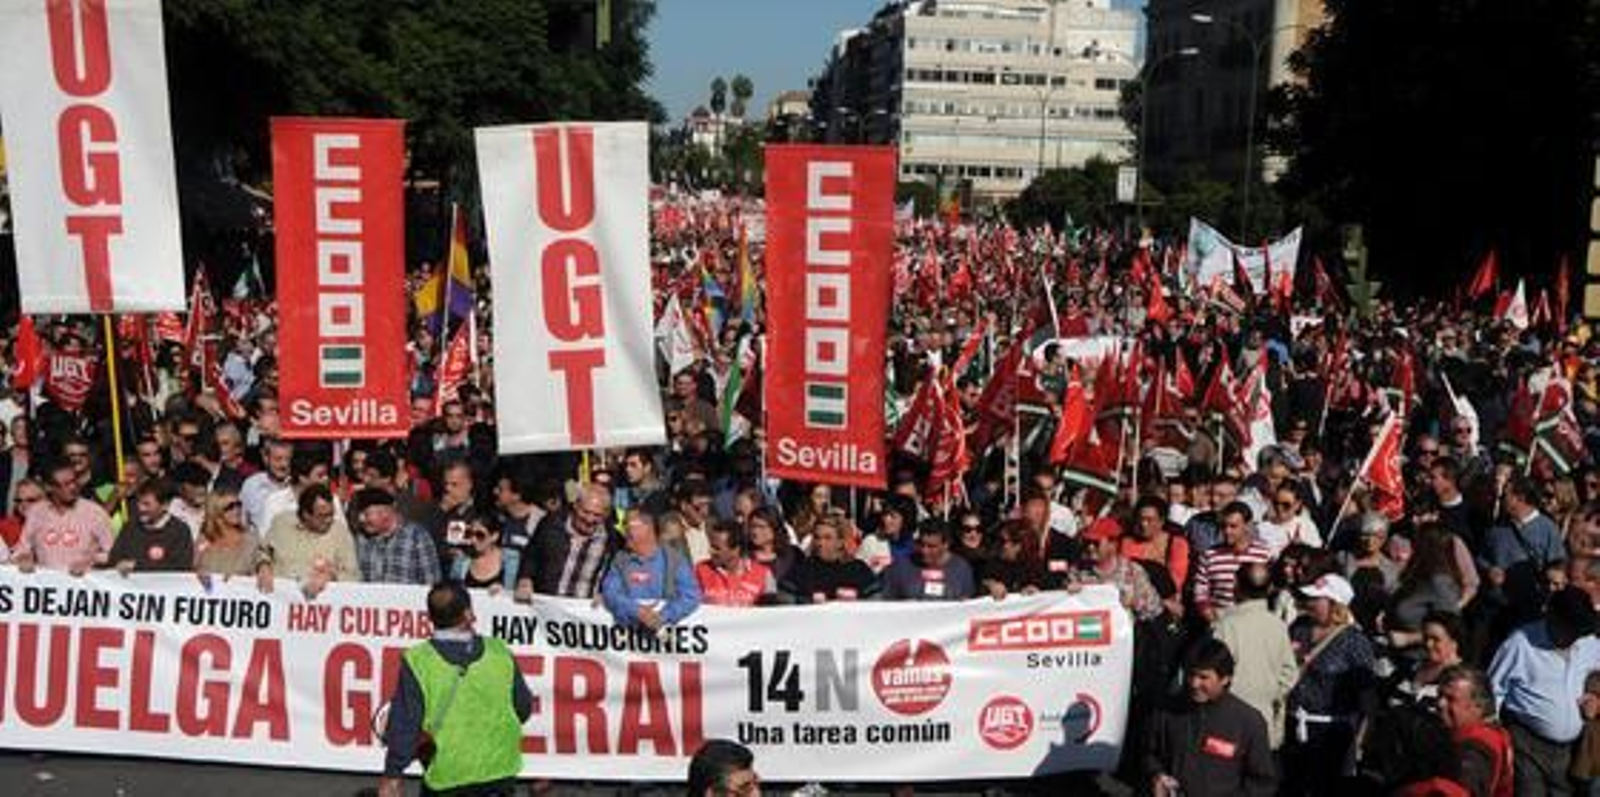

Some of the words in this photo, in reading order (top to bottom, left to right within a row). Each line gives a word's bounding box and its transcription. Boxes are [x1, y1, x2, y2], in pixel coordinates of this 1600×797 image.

[46, 0, 124, 311] UGT
[313, 133, 366, 338] CCOO
[533, 126, 606, 445] UGT
[804, 160, 854, 377] CCOO
[291, 400, 398, 425] Sevilla
[777, 437, 877, 474] Sevilla
[23, 587, 110, 617] DEJAN
[119, 593, 165, 623] SIN
[174, 597, 271, 629] FUTURO
[288, 604, 332, 631] HAY
[340, 606, 434, 639] CULPAB
[491, 615, 538, 644] HAY
[976, 618, 1074, 645] CCOO
[1027, 650, 1103, 669] Sevilla
[323, 642, 705, 757] GERAL
[986, 705, 1027, 728] UGT
[738, 722, 785, 745] Una
[793, 723, 857, 745] tarea
[866, 719, 952, 744] común
